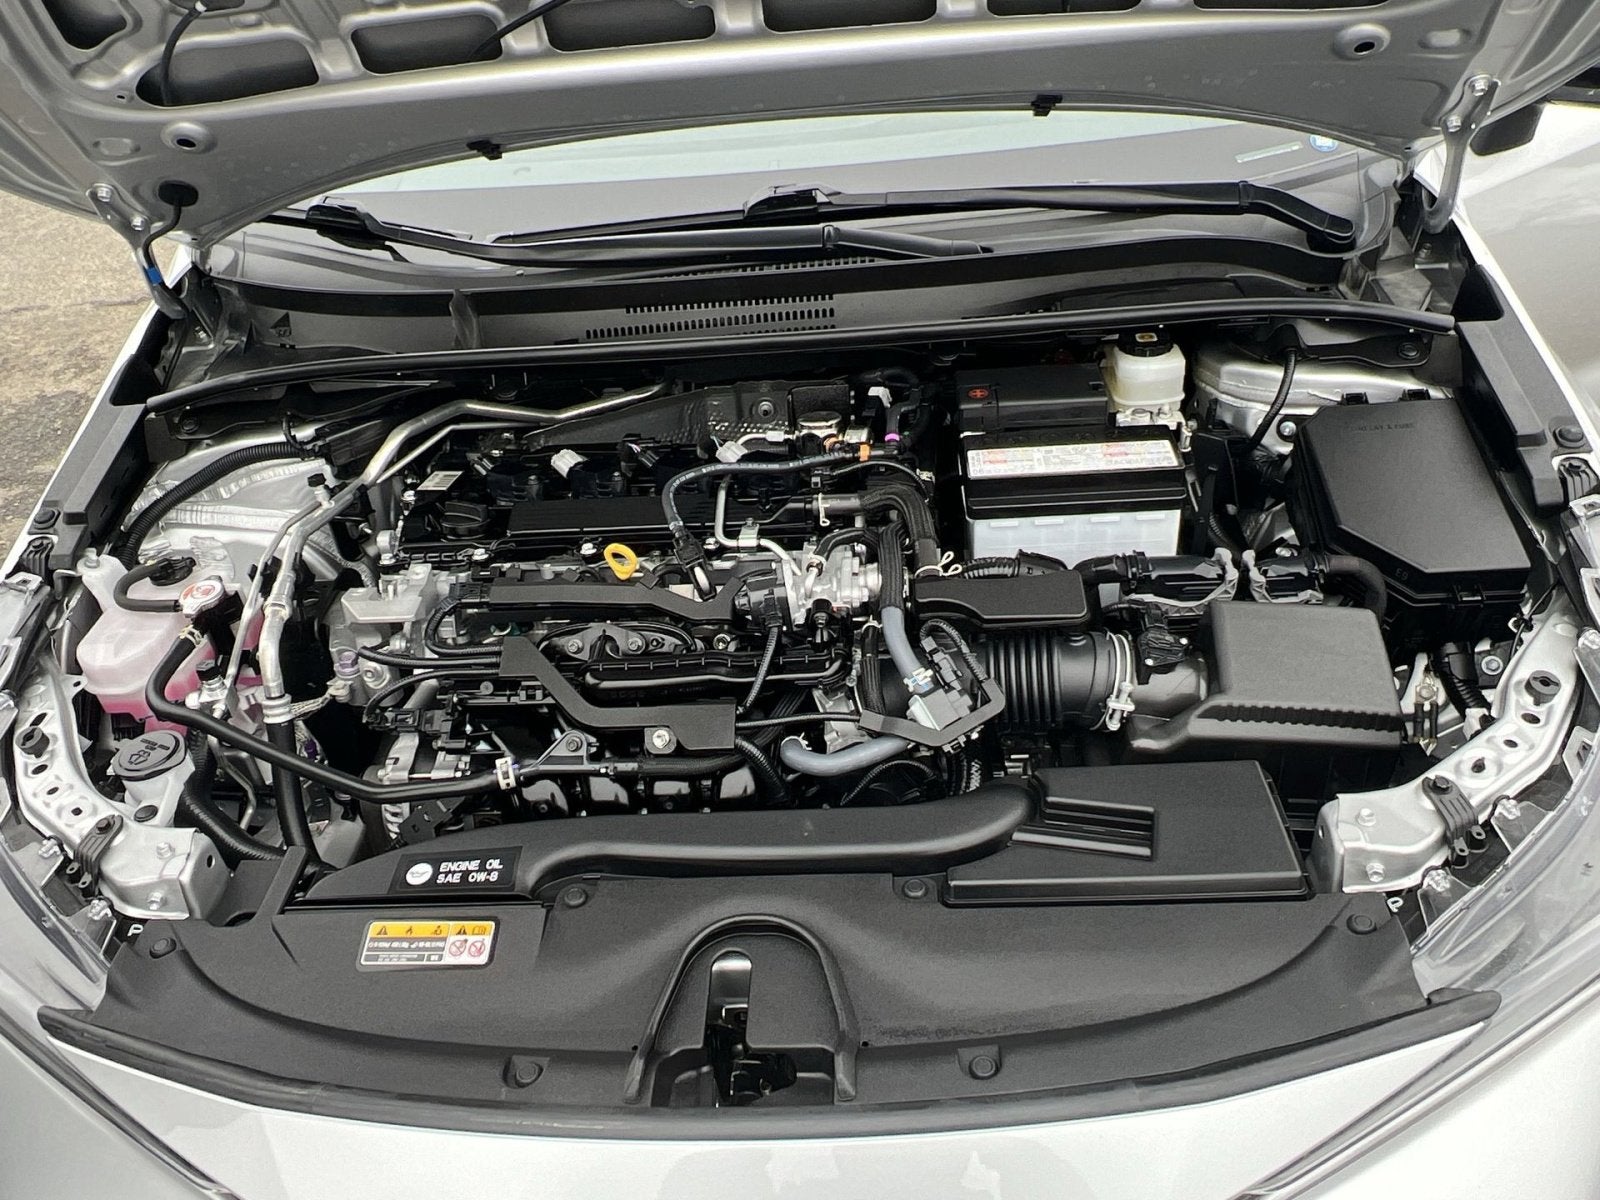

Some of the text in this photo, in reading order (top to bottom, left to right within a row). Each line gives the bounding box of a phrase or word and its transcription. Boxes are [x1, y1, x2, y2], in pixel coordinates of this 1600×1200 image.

[439, 858, 503, 872] ENGINE OIL
[436, 872, 462, 884] SAE
